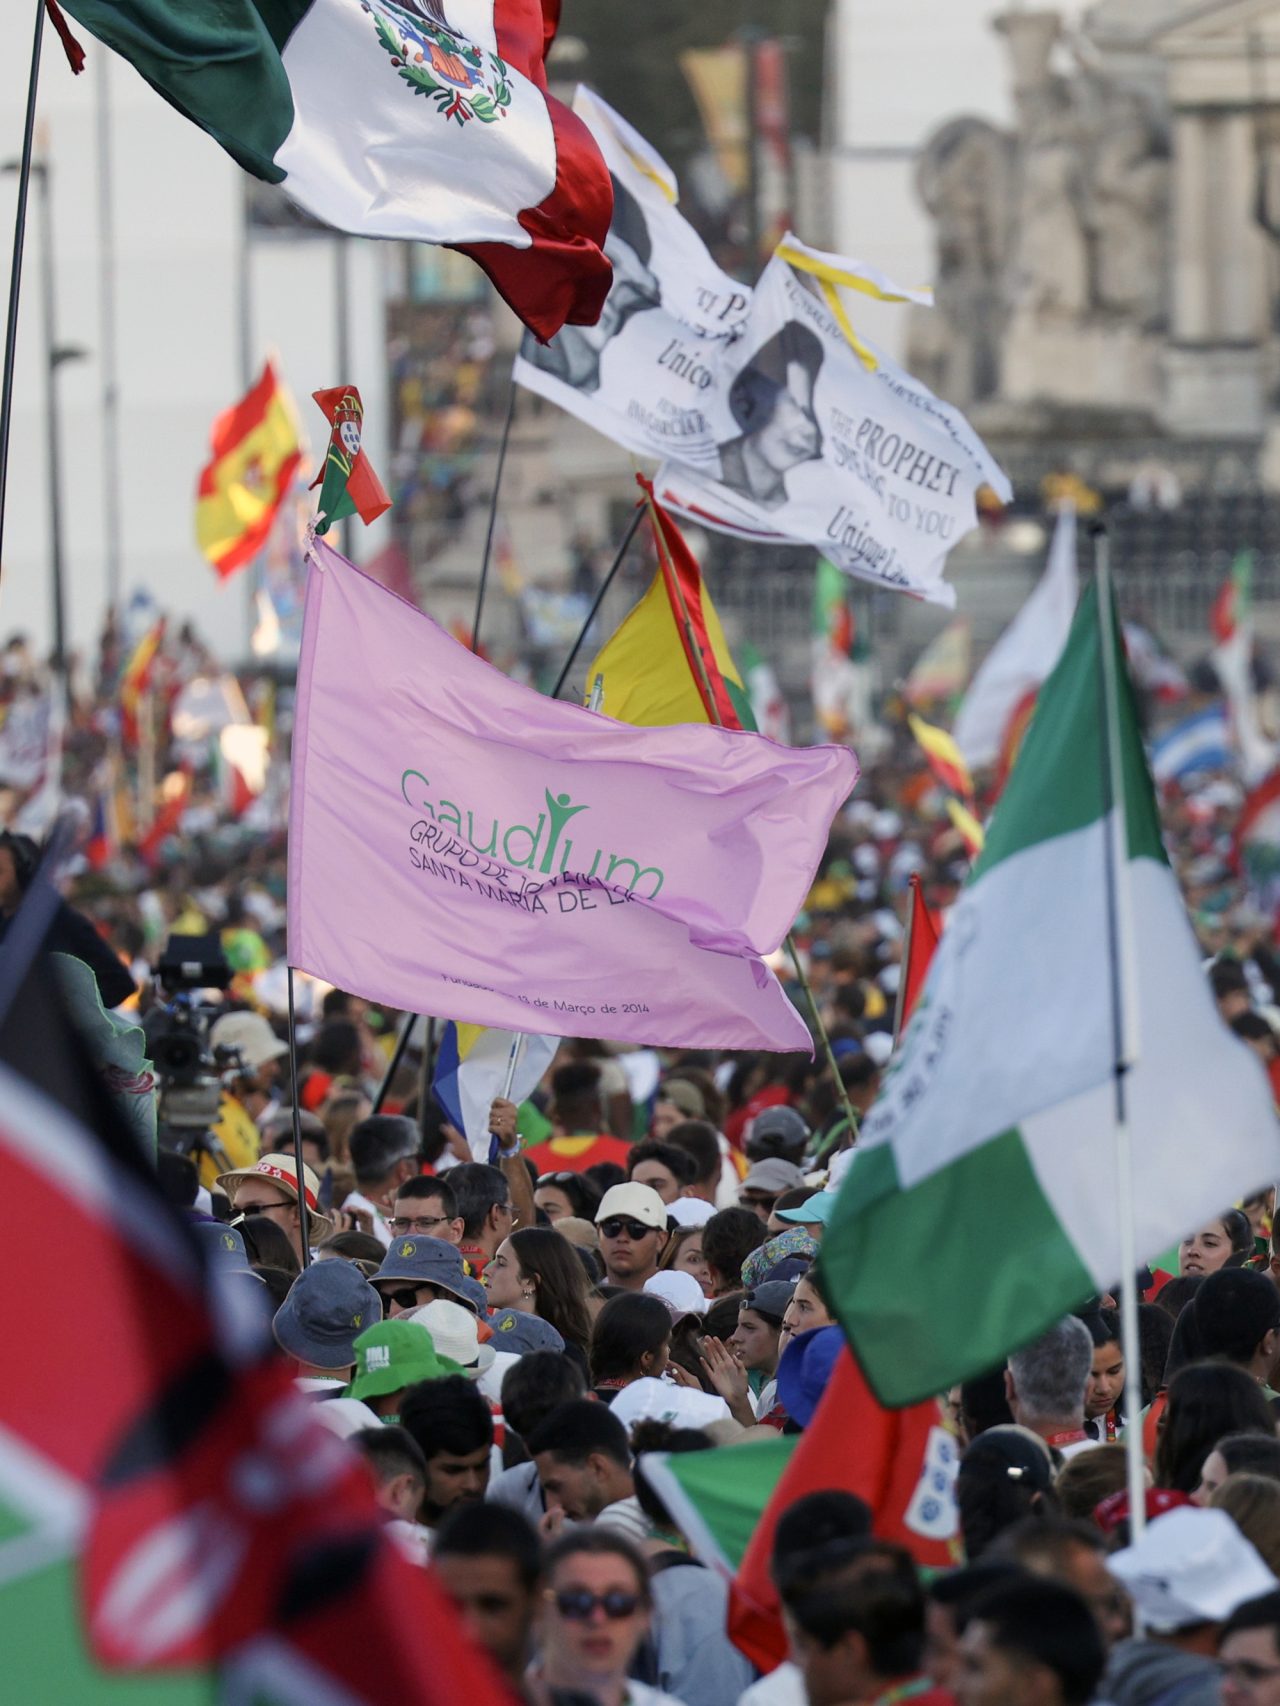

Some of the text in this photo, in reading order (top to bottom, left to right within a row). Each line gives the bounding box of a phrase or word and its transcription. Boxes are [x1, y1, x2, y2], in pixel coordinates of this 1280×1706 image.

[856, 417, 961, 497] PROPHET
[915, 504, 955, 540] YOU
[401, 769, 666, 901] Gaudium
[409, 819, 480, 868] GRUPO
[408, 846, 473, 892] SANTA
[557, 888, 598, 914] DE
[533, 998, 550, 1009] de
[553, 1001, 596, 1016] Março
[600, 1004, 617, 1014] de
[621, 1003, 651, 1014] 2014
